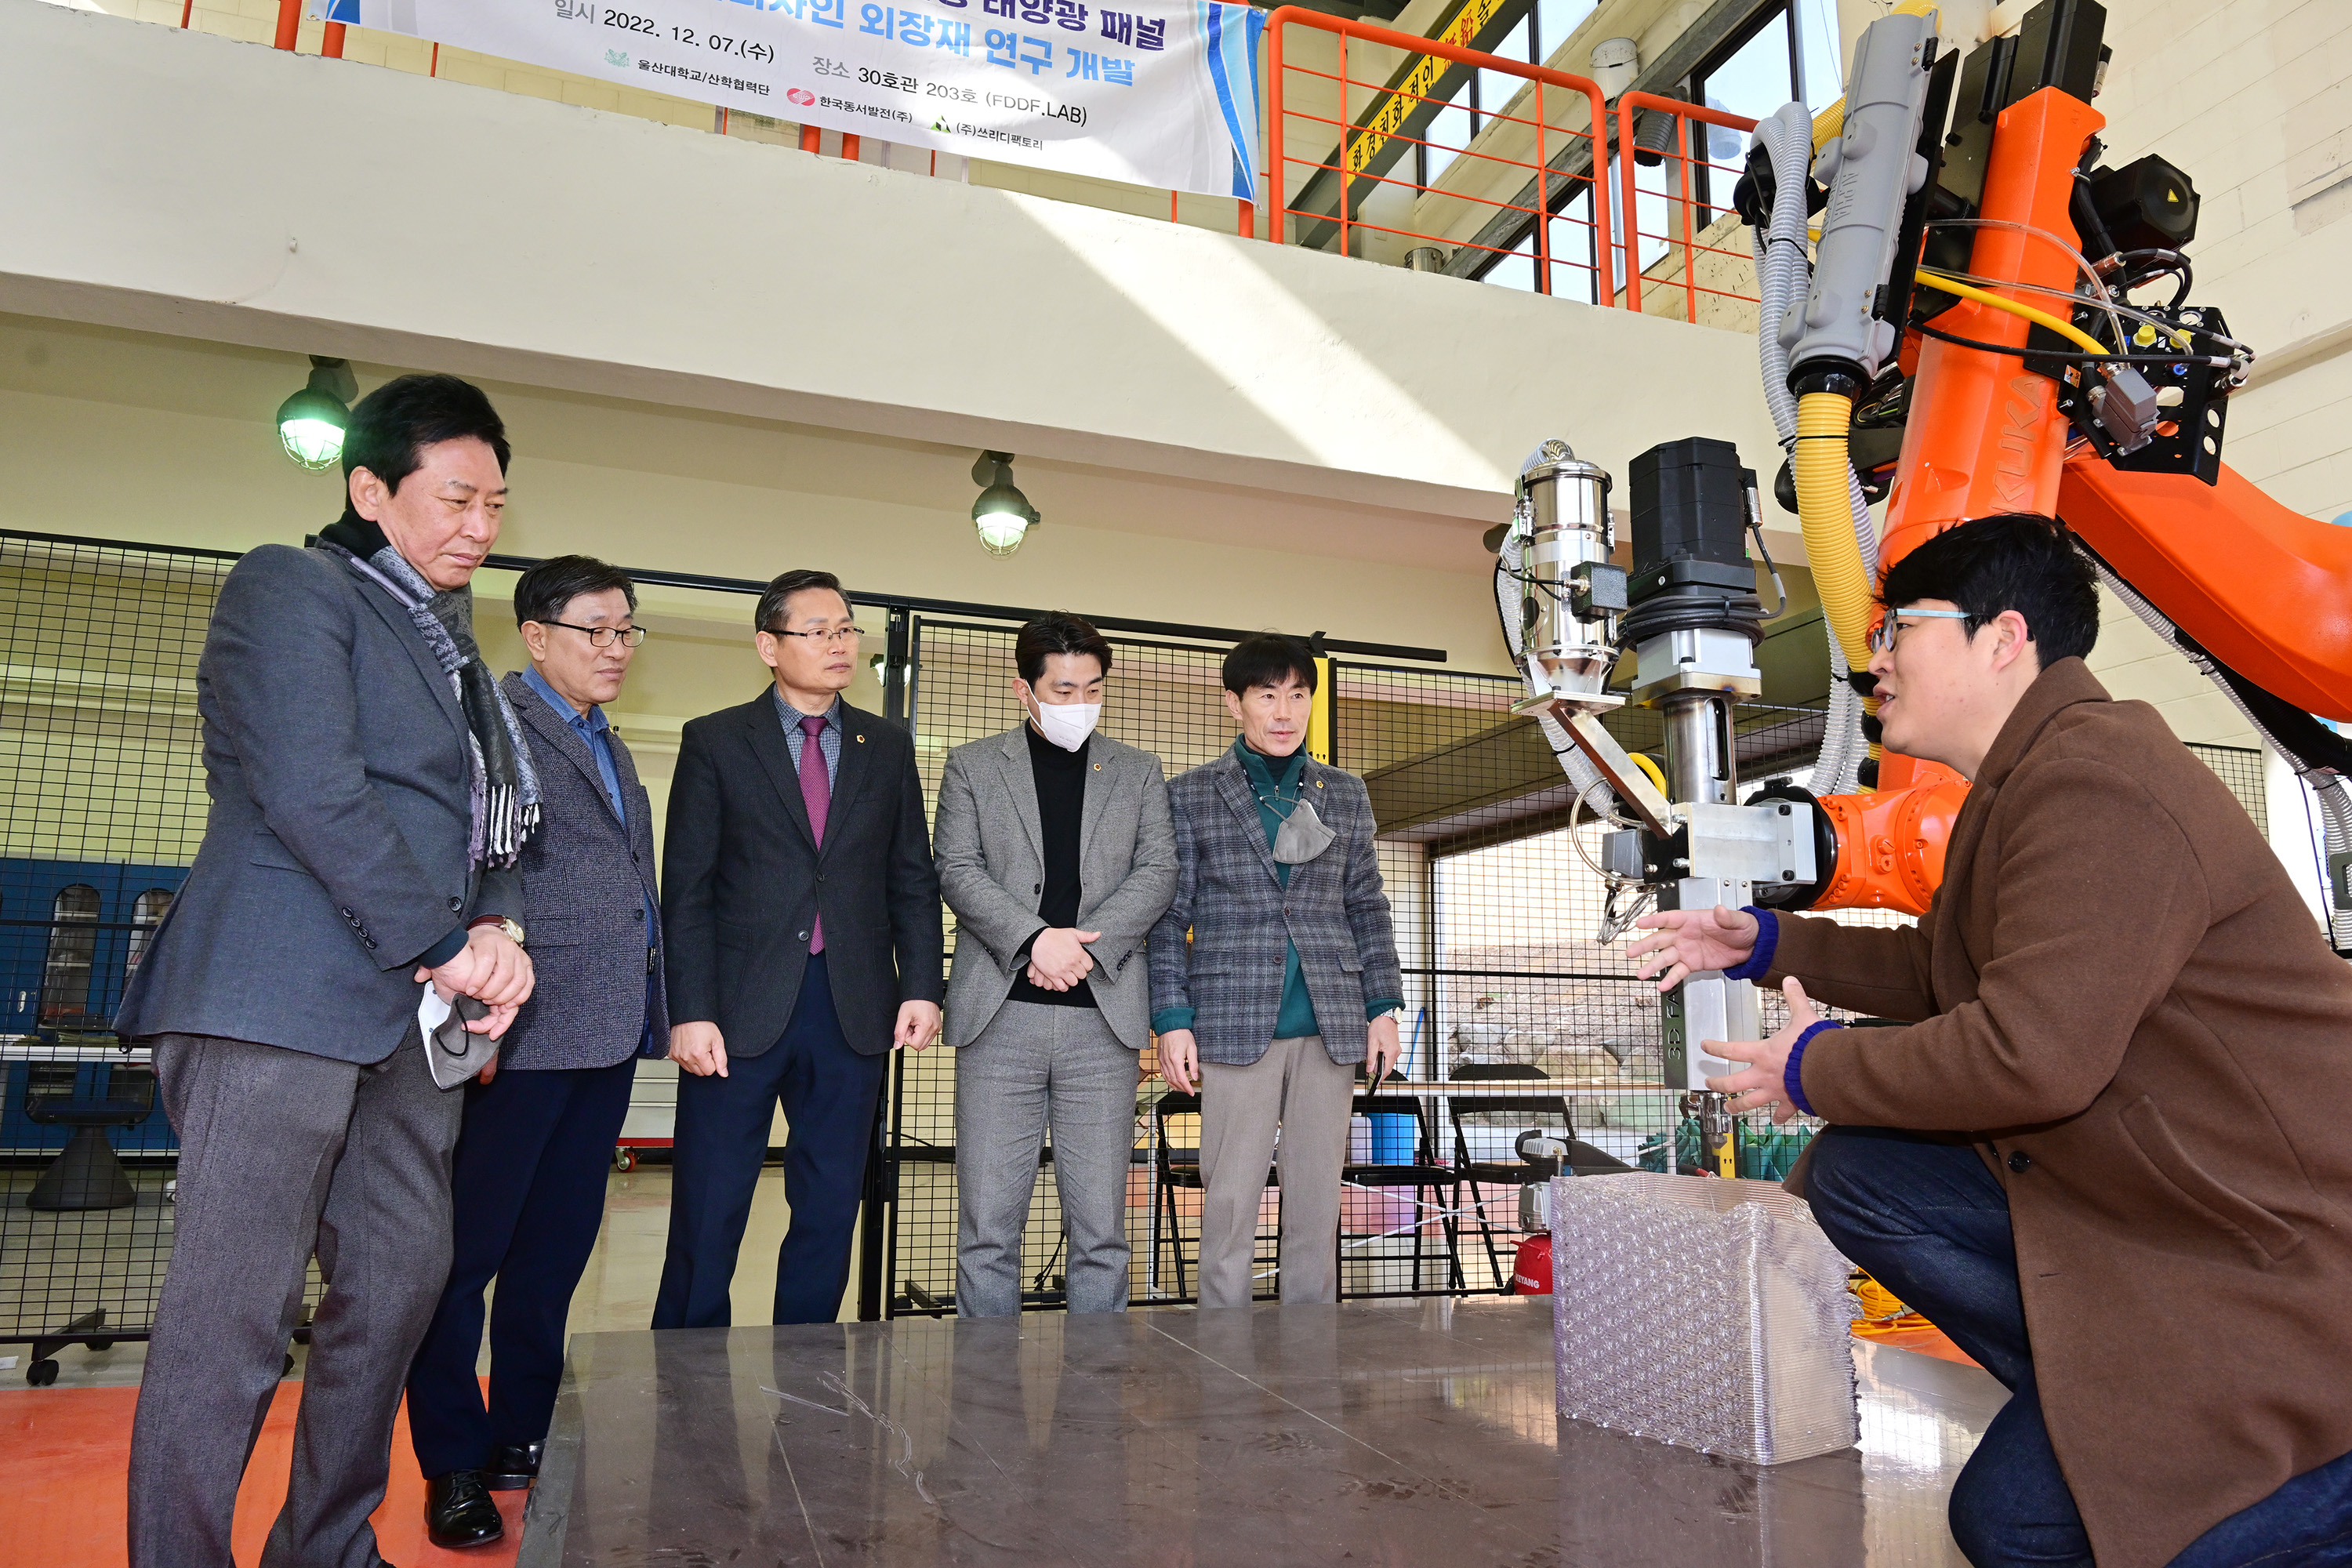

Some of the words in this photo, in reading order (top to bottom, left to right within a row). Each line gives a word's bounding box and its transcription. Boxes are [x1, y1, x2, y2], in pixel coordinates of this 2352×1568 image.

[554, 0, 595, 24] 일시
[604, 9, 660, 37] 2022.
[672, 26, 700, 47] 12.
[709, 35, 775, 64] 07.(수)
[859, 3, 971, 57] 외장재
[985, 28, 1053, 76] 연구
[1066, 47, 1136, 87] 개발
[1100, 9, 1166, 51] 패널
[637, 60, 771, 96] 울산대학교/산학협력단
[812, 56, 851, 79] 장소
[858, 67, 919, 94] 30호관
[926, 82, 978, 104] 203호
[985, 92, 1087, 128] (FDDF.LAB)
[819, 96, 913, 123] 한국동서발전(주)
[956, 122, 1044, 151] (주)쓰리디팩토리
[1991, 373, 2045, 513] KUKA
